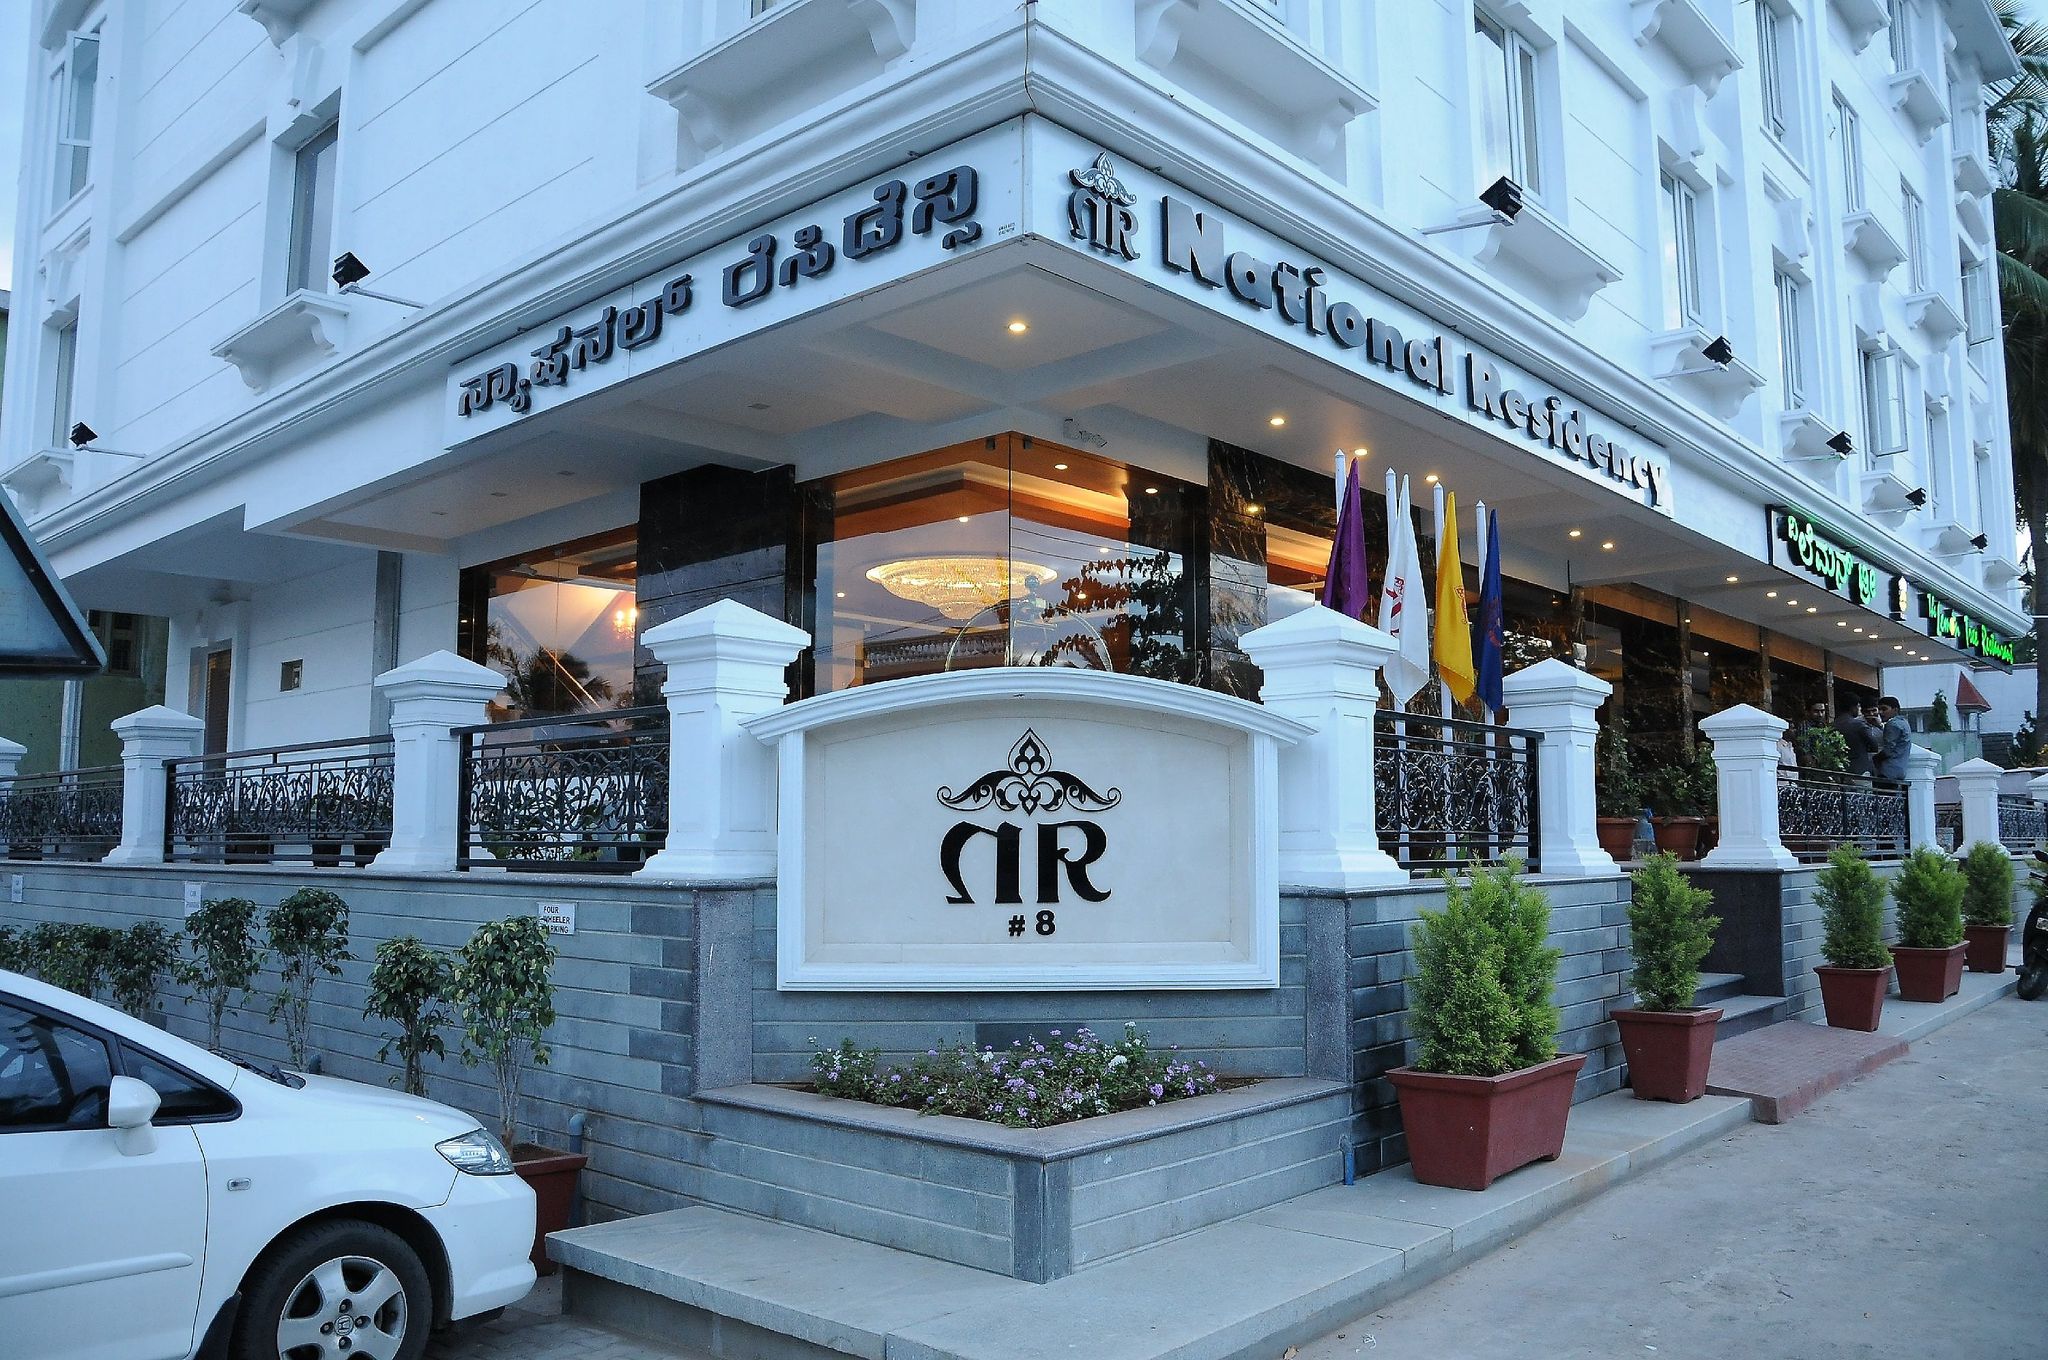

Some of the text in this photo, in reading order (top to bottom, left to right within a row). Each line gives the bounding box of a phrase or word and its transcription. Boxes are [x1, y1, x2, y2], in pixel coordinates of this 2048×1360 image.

[458, 165, 983, 417] ನ್ಯಾಷನಲ್ ರೆಸಿಡೆನ್ಸಿ
[1161, 195, 1664, 507] National Residency
[543, 905, 560, 914] FOUR
